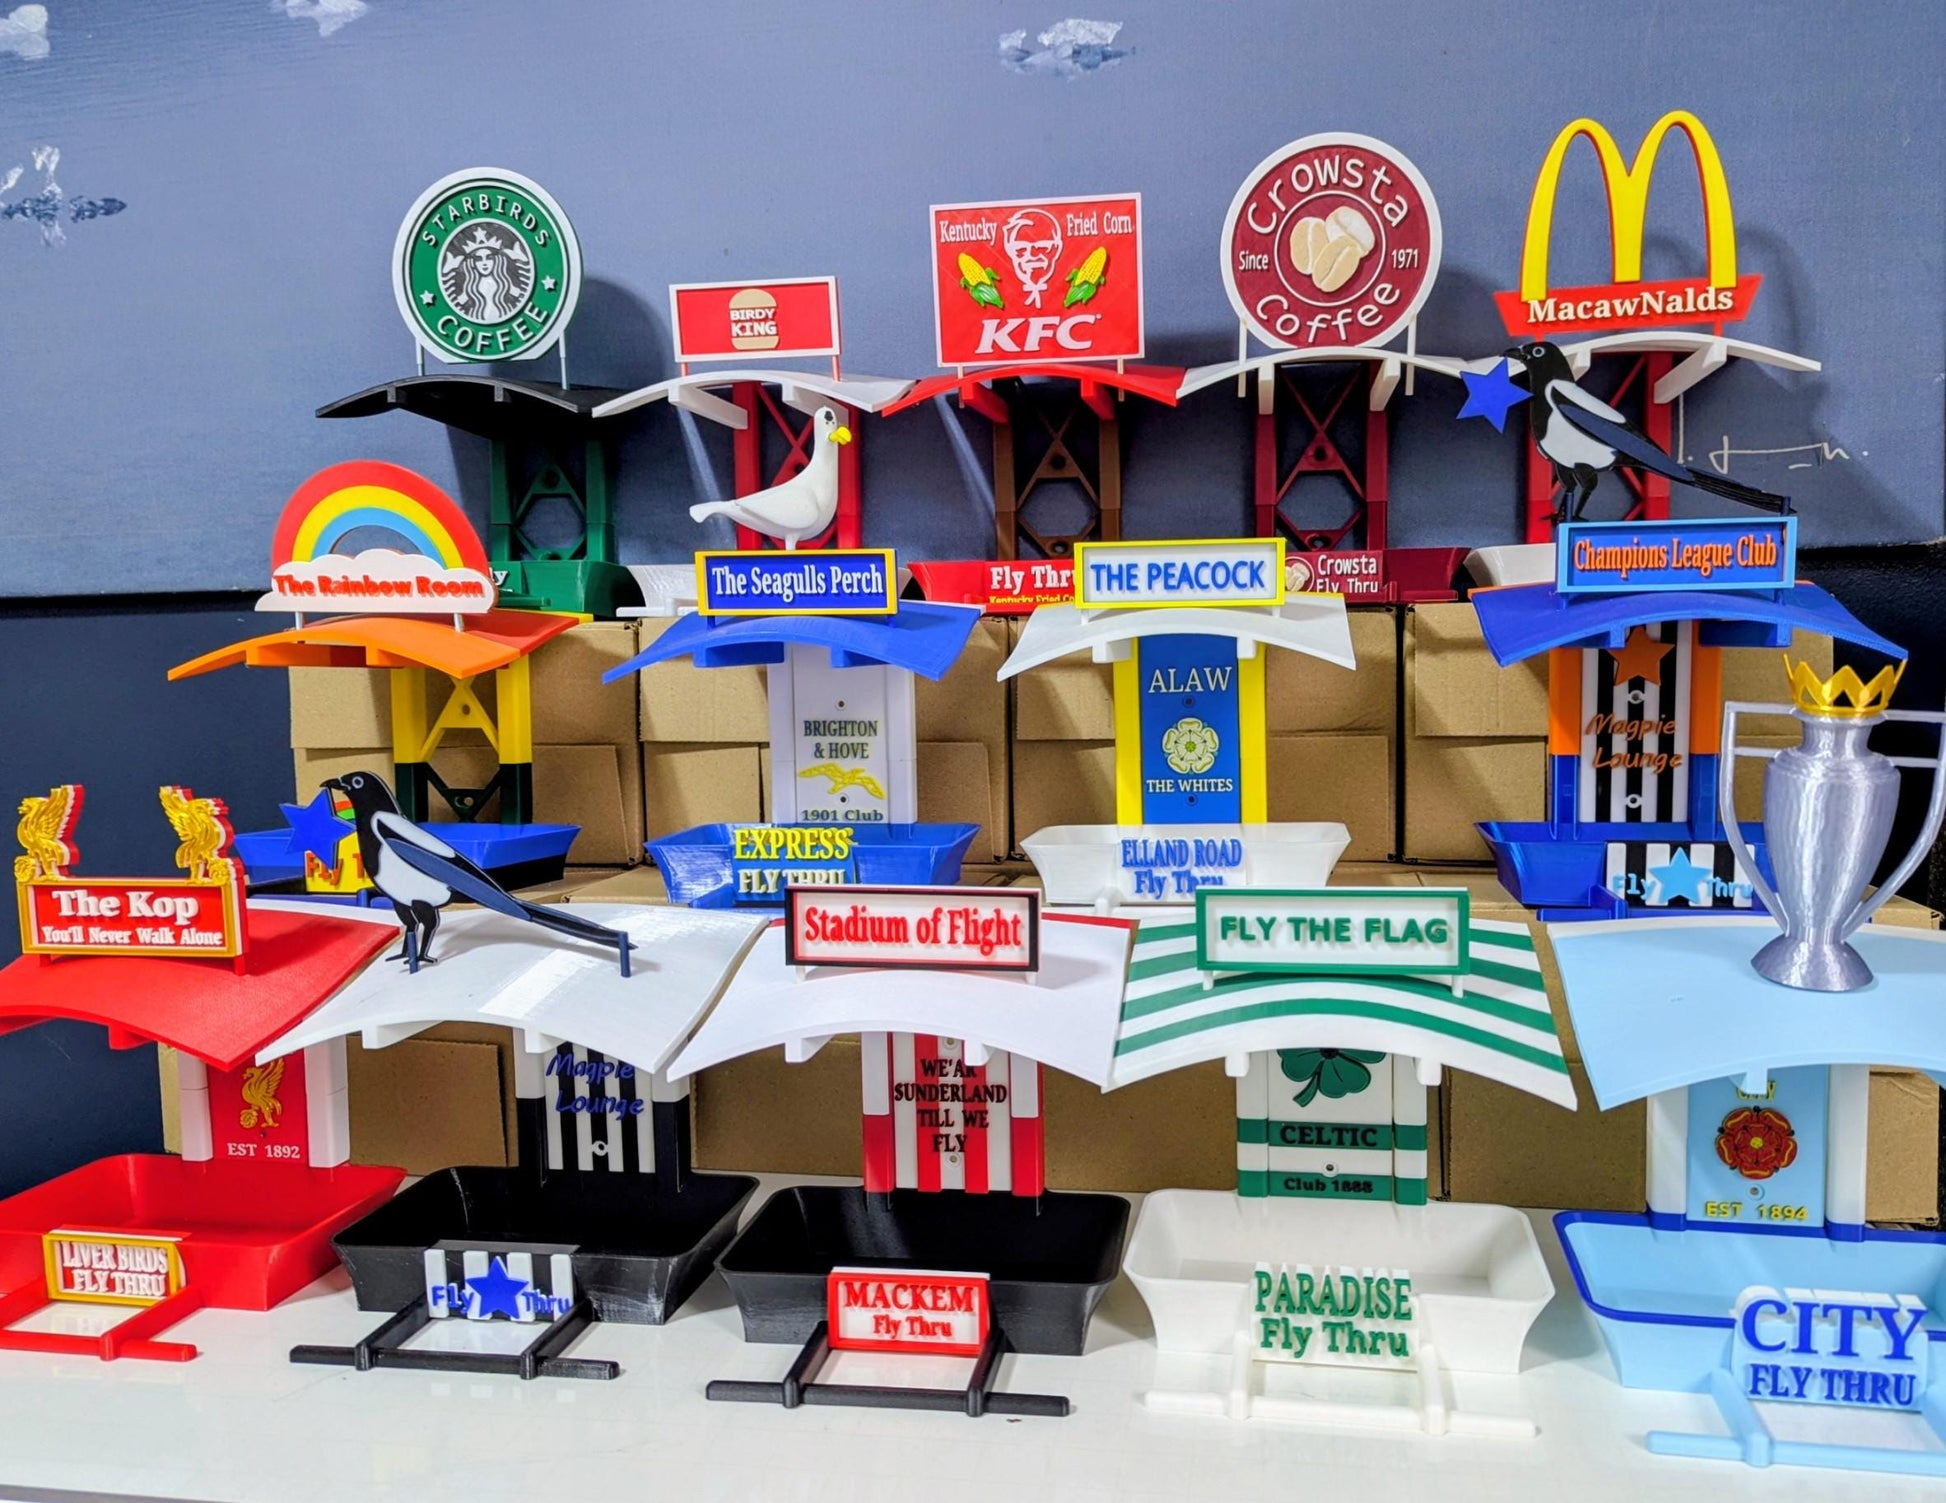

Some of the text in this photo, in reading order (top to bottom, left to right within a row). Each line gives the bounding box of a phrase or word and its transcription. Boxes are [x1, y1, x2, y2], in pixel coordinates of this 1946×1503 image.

[1248, 155, 1408, 235] Crowsta
[422, 193, 549, 246] STARBIRDS
[939, 212, 1133, 246] Kentucky Fried Corn
[1238, 250, 1269, 271] Since
[1391, 248, 1419, 269] 1971
[730, 308, 775, 321] BIRDY
[1256, 282, 1400, 343] Coffee
[1527, 286, 1734, 324] MacawNalds
[437, 300, 548, 353] COFFEE
[731, 322, 777, 337] KING
[974, 314, 1098, 354] KFC
[1317, 554, 1377, 575] Crowsta
[1574, 534, 1777, 579] Champions League Club
[272, 574, 483, 598] The Rainbow Room
[712, 563, 883, 603] The Seagulls Perch
[990, 564, 1075, 595] Fly Thr
[1090, 560, 1265, 592] THE PEACOCK
[1316, 577, 1378, 593] Fly Thru
[989, 594, 1034, 604] Kentucky
[1036, 594, 1060, 602] Fried
[1148, 667, 1232, 693] ALAW
[804, 720, 878, 737] BRIGHTON
[1585, 713, 1676, 741] Magpie
[814, 742, 869, 759] & HOVE
[1592, 747, 1684, 775] Lounge
[1146, 778, 1233, 793] THE WHITES
[802, 809, 883, 821] 1901 Club
[734, 828, 850, 859] EXPRESS
[1121, 838, 1243, 868] ELLAND ROAD
[738, 869, 781, 894] FLY
[1134, 869, 1167, 900] Fly
[1612, 873, 1754, 900] Fly Thru
[52, 889, 199, 926] The Kop
[42, 926, 222, 945] You'll Never Walk Alone
[805, 905, 1021, 956] Stadium of Flight
[1220, 916, 1448, 944] FLY THE FLAG
[546, 1053, 635, 1085] Magpie
[556, 1090, 644, 1121] Lounge
[894, 1083, 1007, 1103] SUNDERLAND
[917, 1109, 989, 1129] TILL WE
[933, 1134, 968, 1153] FLY
[1280, 1125, 1378, 1147] CELTIC
[227, 1143, 300, 1159] EST 1892
[1284, 1177, 1373, 1194] Club 1888
[1705, 1201, 1808, 1221] EST 1894
[61, 1241, 168, 1274] LIVER BIRDS
[72, 1269, 166, 1296] FLY THRU
[844, 1281, 974, 1312] MACKEM
[1254, 1270, 1412, 1321] PARADISE
[431, 1283, 571, 1316] Fly Thru
[873, 1314, 953, 1339] Fly Thru
[1260, 1317, 1409, 1359] Fly Thru
[1742, 1299, 1928, 1361] CITY
[1750, 1363, 1916, 1406] FLY THRU
